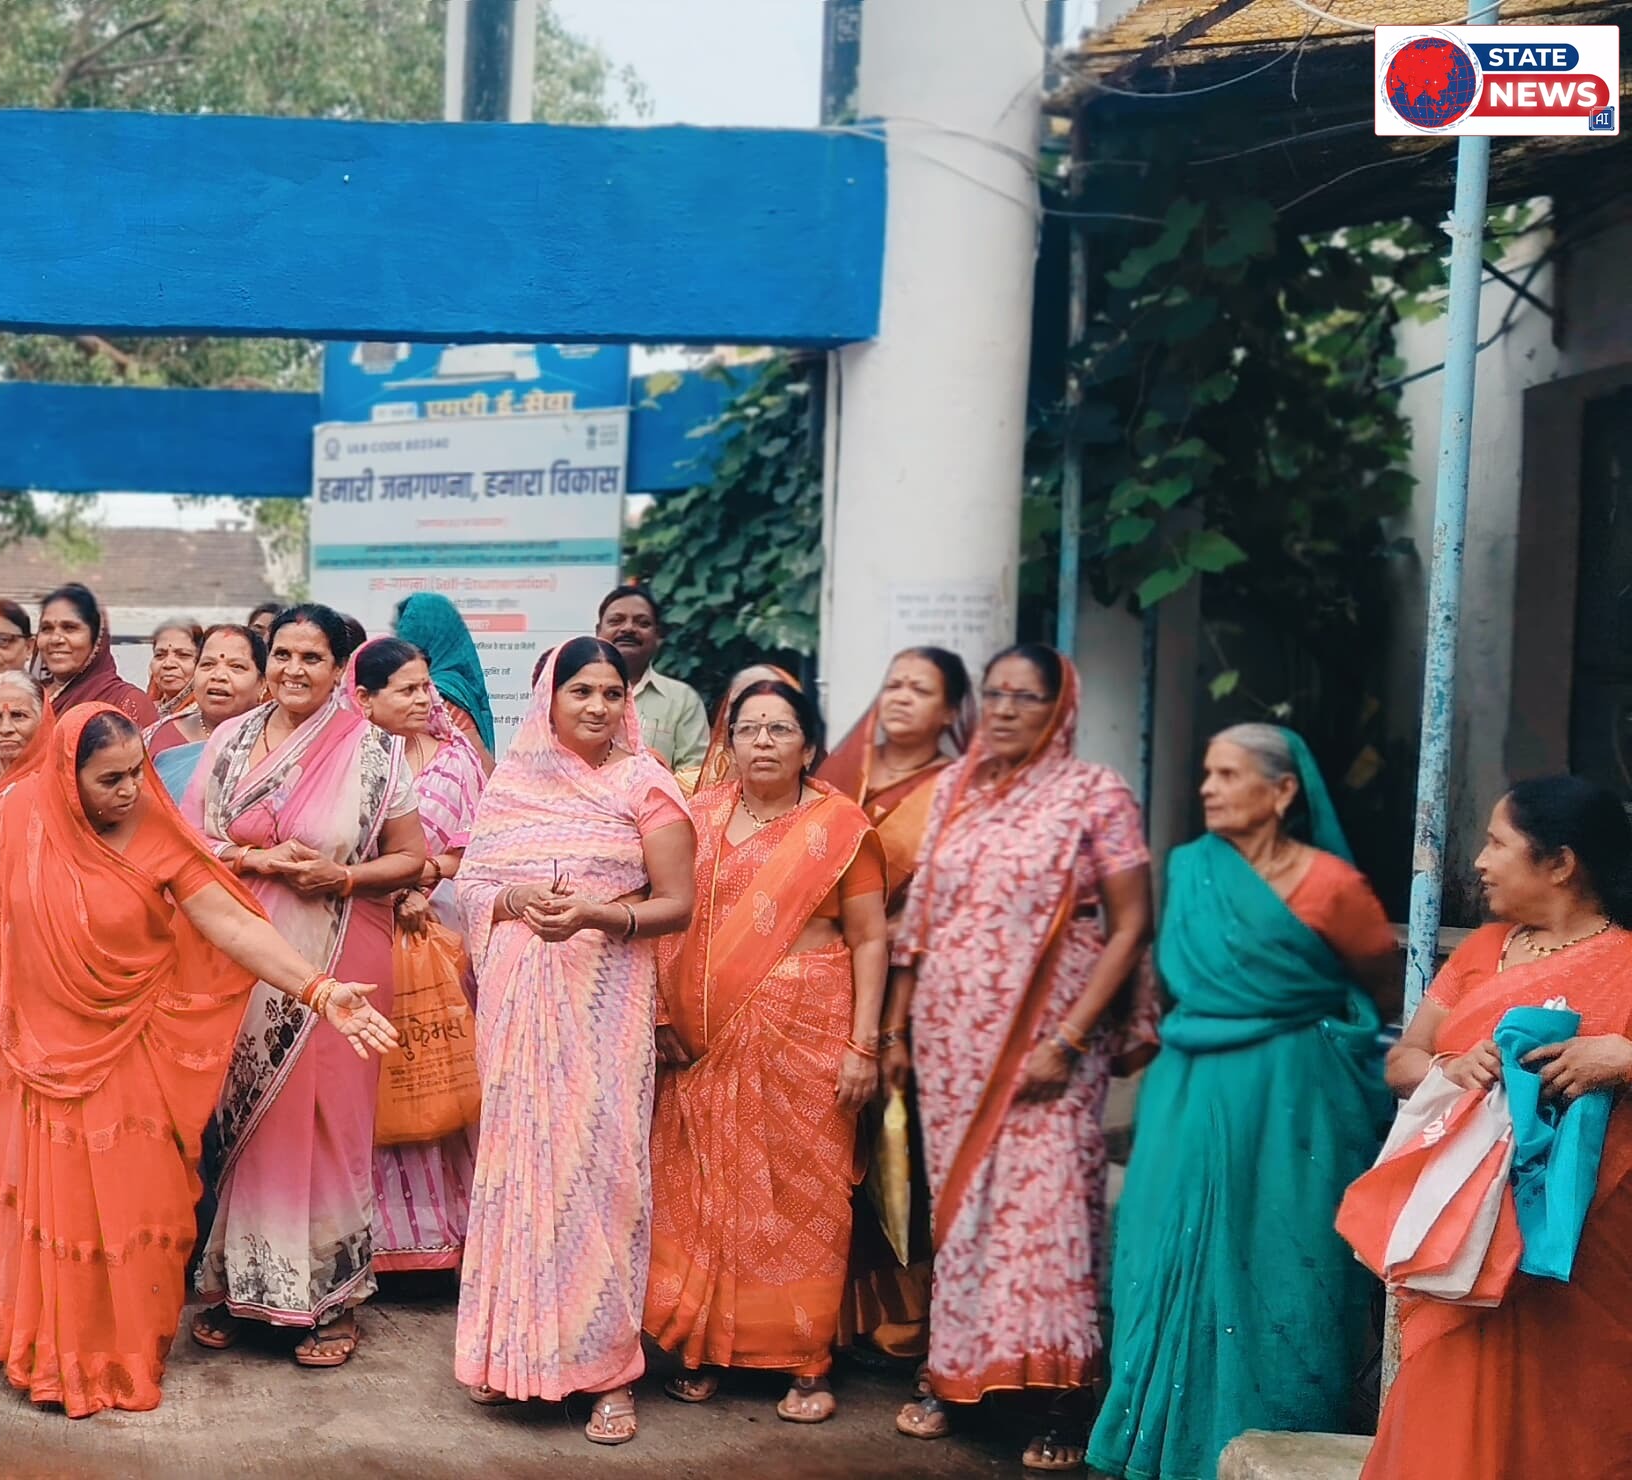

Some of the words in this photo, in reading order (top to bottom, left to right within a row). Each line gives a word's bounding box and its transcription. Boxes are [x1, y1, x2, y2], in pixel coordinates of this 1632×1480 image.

[319, 469, 373, 504] हमारी
[379, 471, 478, 502] जनगणना,
[484, 469, 544, 498] हमारा
[550, 459, 620, 495] विकास
